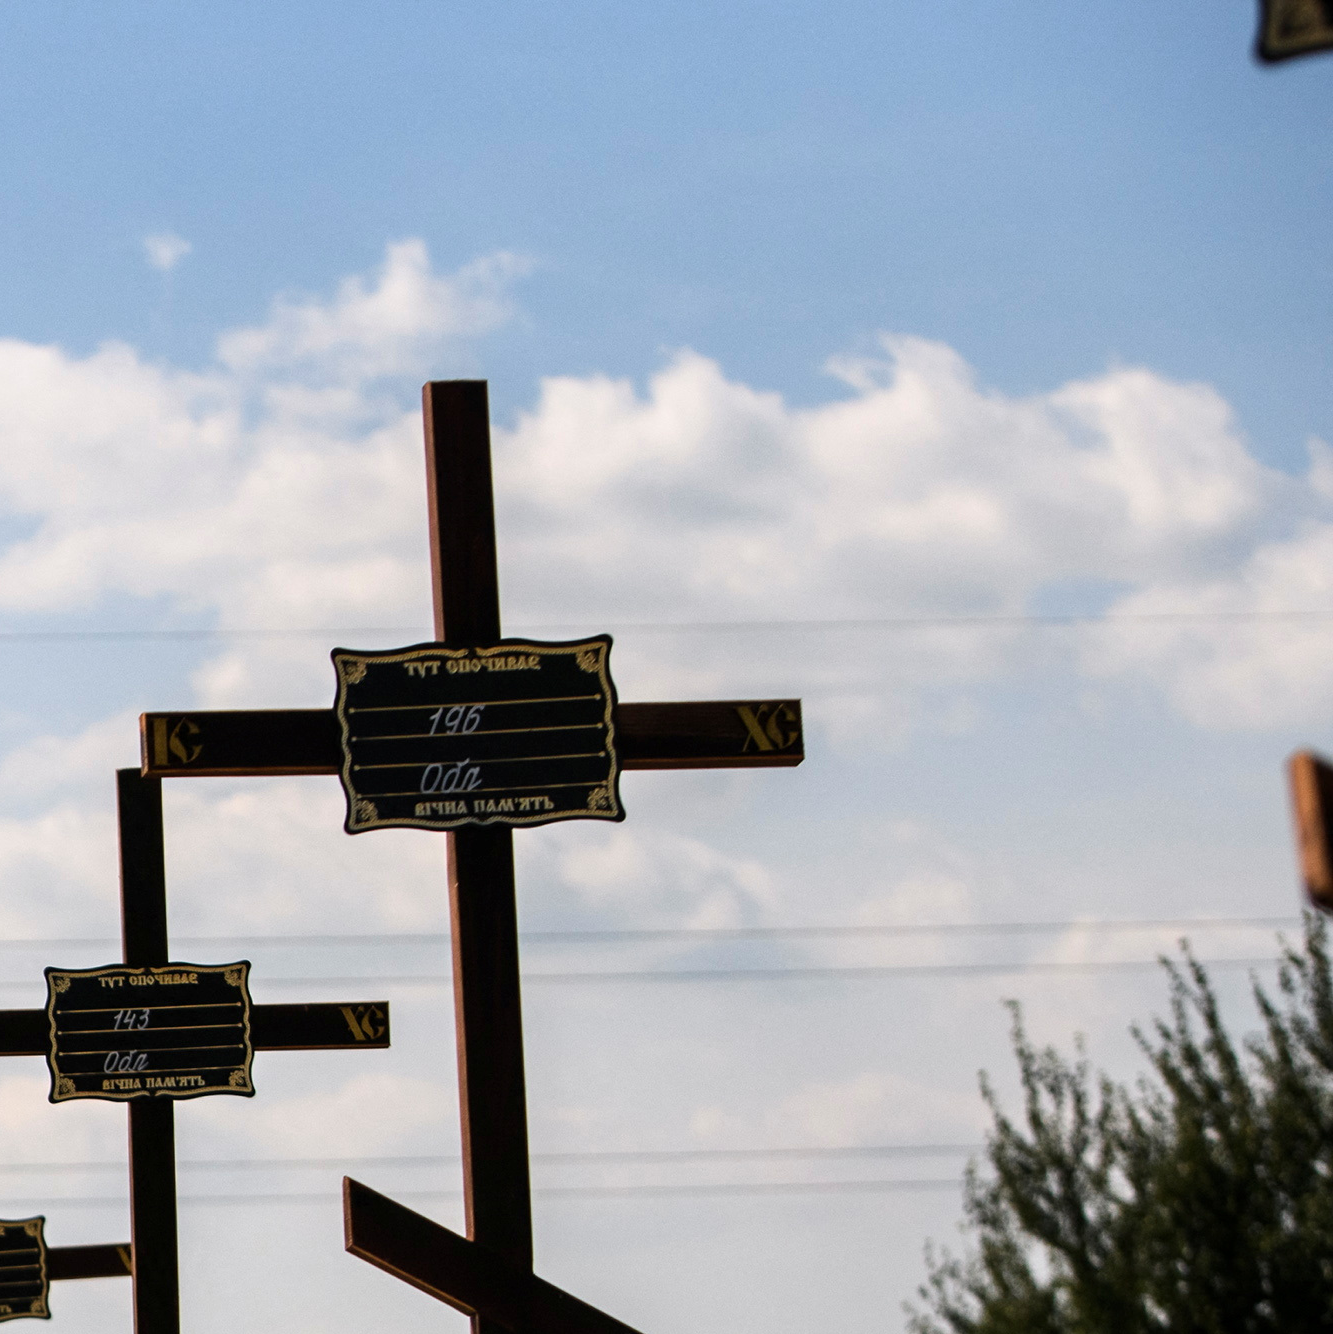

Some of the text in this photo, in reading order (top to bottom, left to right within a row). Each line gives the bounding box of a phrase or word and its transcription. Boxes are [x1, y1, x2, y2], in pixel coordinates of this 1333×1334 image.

[403, 655, 541, 679] ТУТ ОПОЧИВАЄ
[429, 705, 485, 735] 196
[414, 796, 555, 817] ВІЧНА ПАМ'ЯТЬ
[98, 973, 199, 989] ТУТ ОПОЧИВАЄ
[114, 1009, 150, 1030] 143
[102, 1075, 206, 1090] ВІЧНА ПАМ'ЯТЬ
